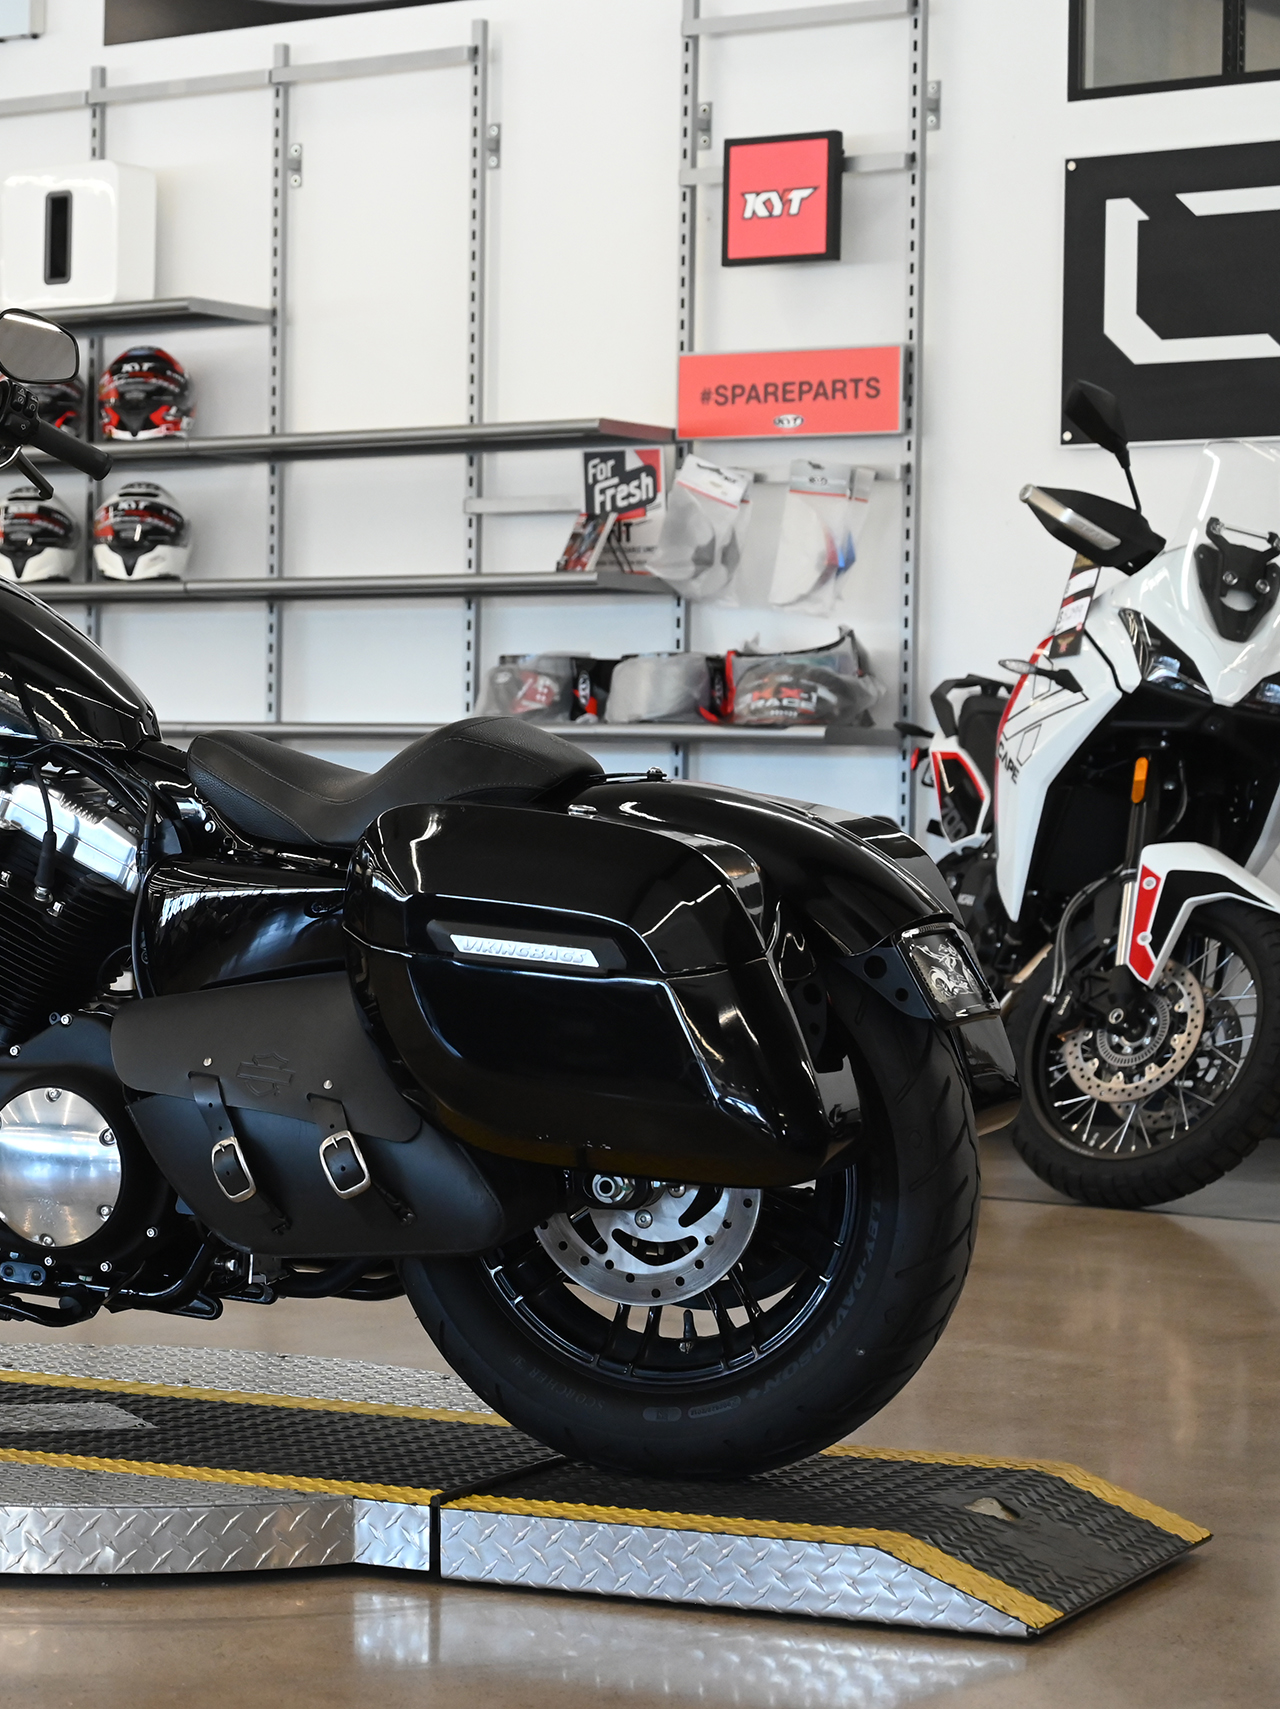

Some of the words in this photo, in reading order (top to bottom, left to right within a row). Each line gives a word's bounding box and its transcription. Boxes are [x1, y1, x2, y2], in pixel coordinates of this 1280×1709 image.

[741, 186, 819, 220] KYT
[699, 377, 881, 406] #SPAREPARTS
[587, 457, 615, 485] For
[593, 472, 654, 515] Fresh
[529, 1367, 605, 1411] SCORCHER
